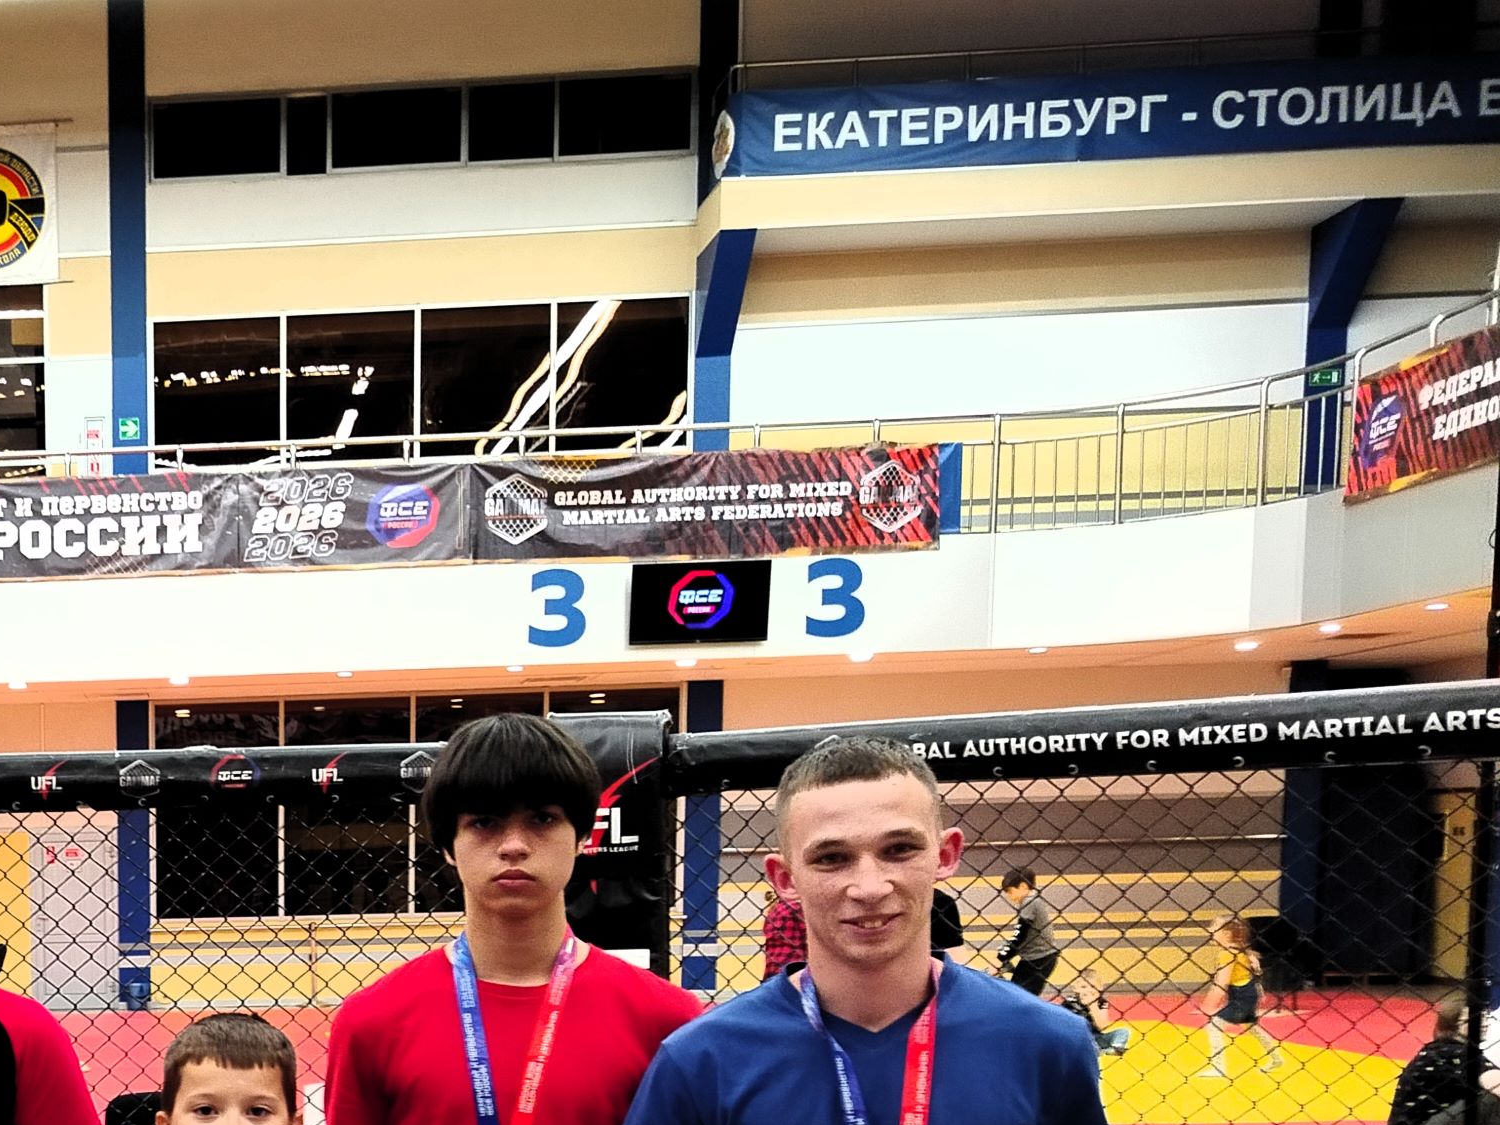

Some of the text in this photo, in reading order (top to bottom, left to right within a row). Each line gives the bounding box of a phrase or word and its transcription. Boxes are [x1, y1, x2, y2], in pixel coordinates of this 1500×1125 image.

[773, 94, 1169, 153] ЕКАТЕРИНБУРГ
[1212, 80, 1462, 130] СТОЛИЦА
[1432, 395, 1500, 441] ЕДИНО
[258, 472, 353, 505] 2026
[554, 481, 852, 506] GLOBAL AUTHORITY FOR MIXED
[250, 502, 346, 533] 2026
[380, 501, 430, 517] ФСЕ
[562, 500, 843, 526] MARTIAL ARTS FEDERATIONS
[242, 530, 336, 563] 2026
[528, 569, 587, 647] 3
[679, 589, 723, 604] ФСЕ
[806, 558, 866, 637] 3
[912, 707, 1500, 760] BAL AUTHORITY FOR MIXED MARTIAL ARTS
[30, 776, 63, 791] UFL
[218, 769, 253, 781] ФСЕ
[311, 768, 344, 783] UFL
[583, 807, 639, 844] FL
[609, 845, 639, 853] LEAGUE
